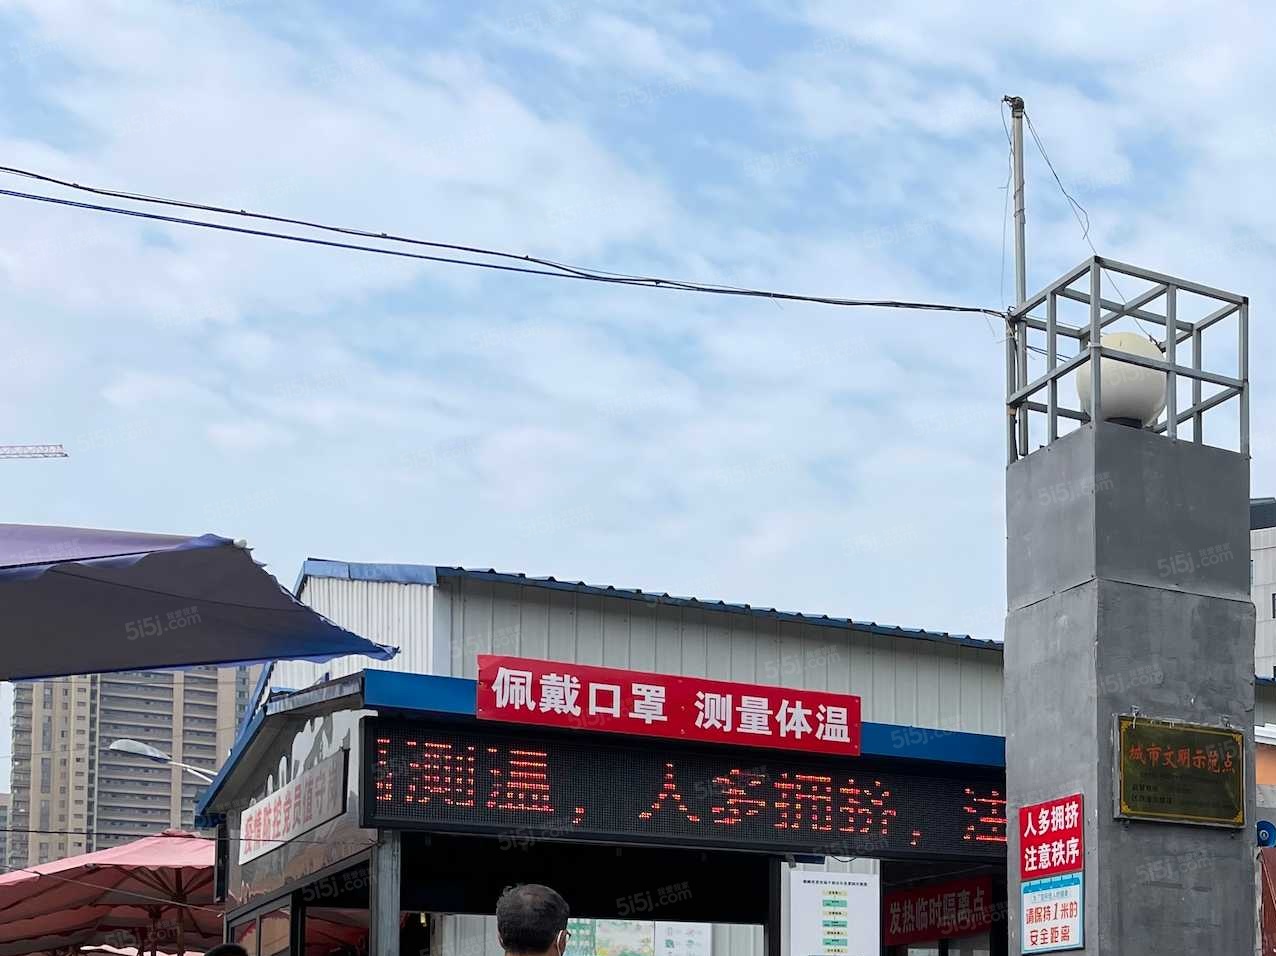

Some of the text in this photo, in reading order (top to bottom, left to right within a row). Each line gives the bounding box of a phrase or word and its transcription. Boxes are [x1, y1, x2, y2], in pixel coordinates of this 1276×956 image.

[492, 666, 851, 743] 佩戴口罩 测量体温
[1024, 801, 1080, 838] 人多拥挤
[1024, 837, 1080, 873] 注意秩序
[1030, 925, 1070, 946] 安全距离
